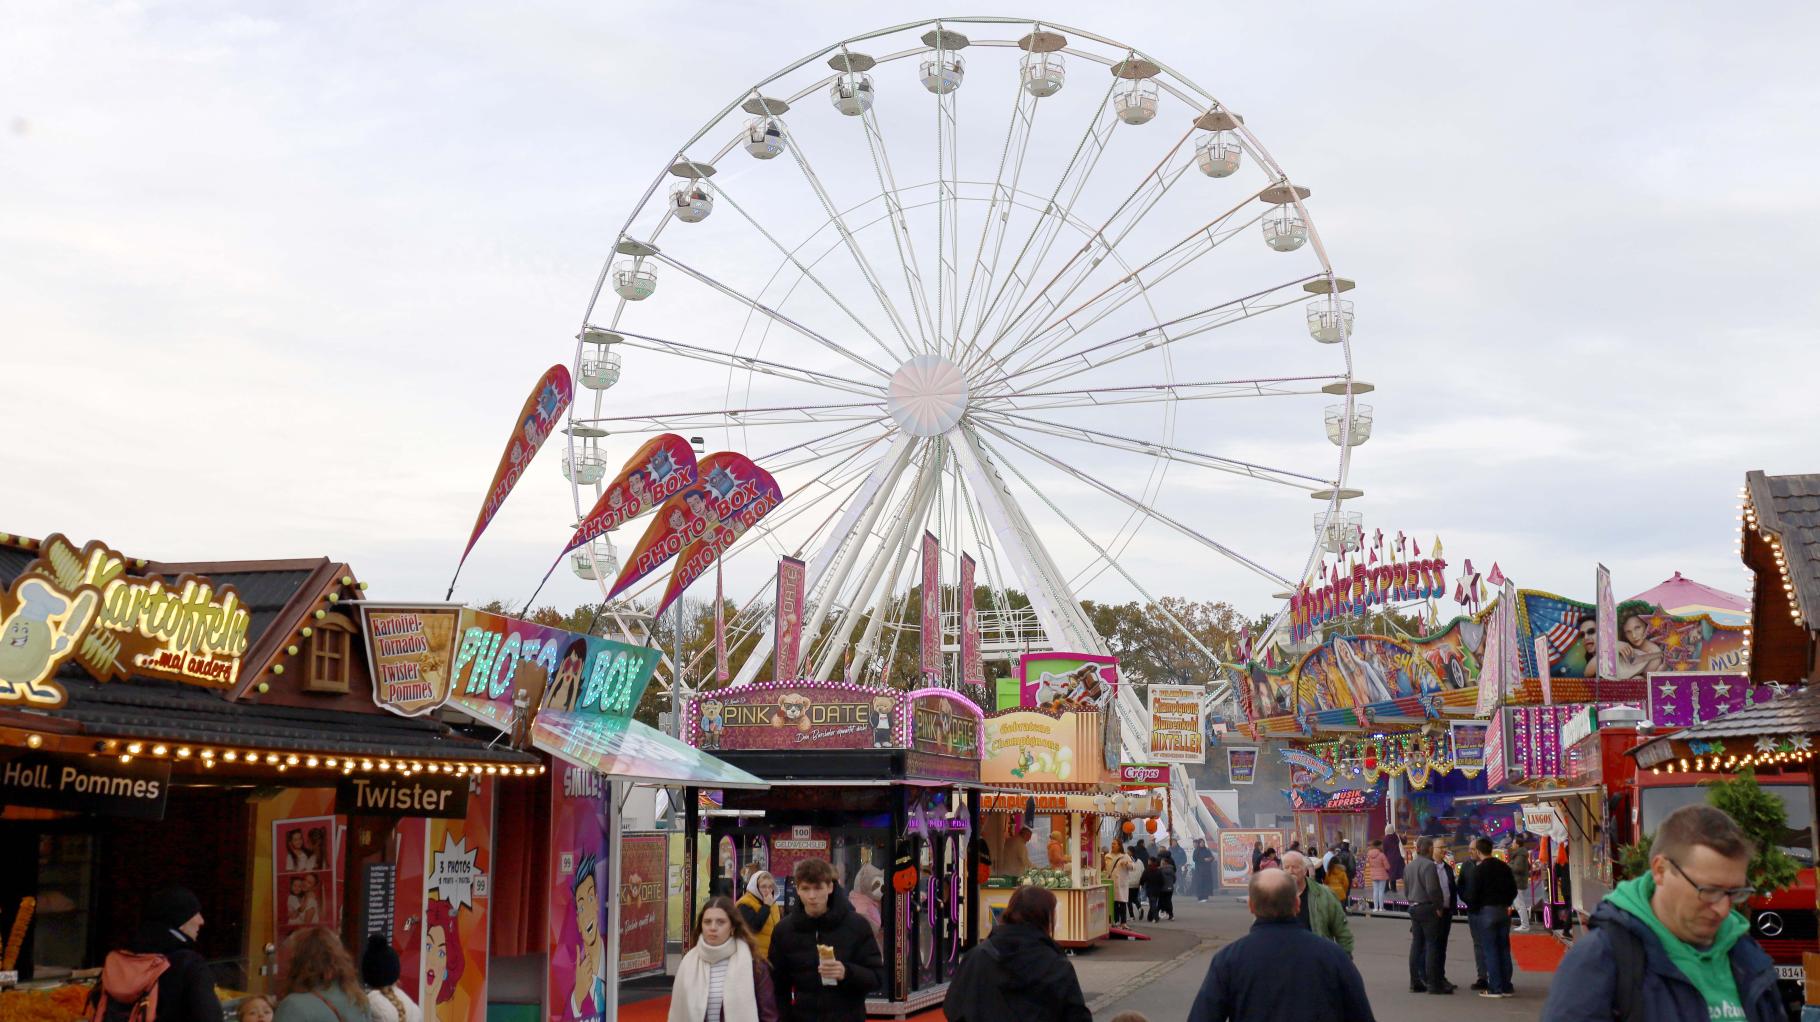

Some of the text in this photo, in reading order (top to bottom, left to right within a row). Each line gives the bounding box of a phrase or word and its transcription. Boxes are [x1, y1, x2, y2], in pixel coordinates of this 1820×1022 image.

[485, 444, 536, 521] PHOTO
[571, 466, 693, 547] PHOTO BOX
[637, 479, 765, 574] PHOTO BOX
[678, 489, 779, 588] PHOTO BOX
[1289, 558, 1447, 646] MUSIK EXPRESS
[378, 633, 426, 657] Tornados
[380, 661, 418, 684] Twister
[582, 650, 644, 712] BOX
[388, 681, 433, 702] Pommes
[724, 704, 868, 724] PINK DATE
[1153, 697, 1199, 716] Champignons
[917, 711, 973, 745] PINK DATE
[1153, 714, 1199, 734] Blumenkohl
[1151, 731, 1202, 755] MIXTELLER
[4, 762, 160, 800] Holl. Pommes
[1124, 766, 1159, 781] Crêpes
[353, 778, 453, 812] Twister
[1327, 796, 1366, 808] EXPRESS
[1332, 790, 1361, 801] MUSIK
[794, 829, 809, 837] 100
[775, 840, 826, 849] GELDWECHSLER
[440, 860, 471, 874] 3 PHOTOS
[476, 880, 486, 891] 99
[642, 883, 661, 901] DATE
